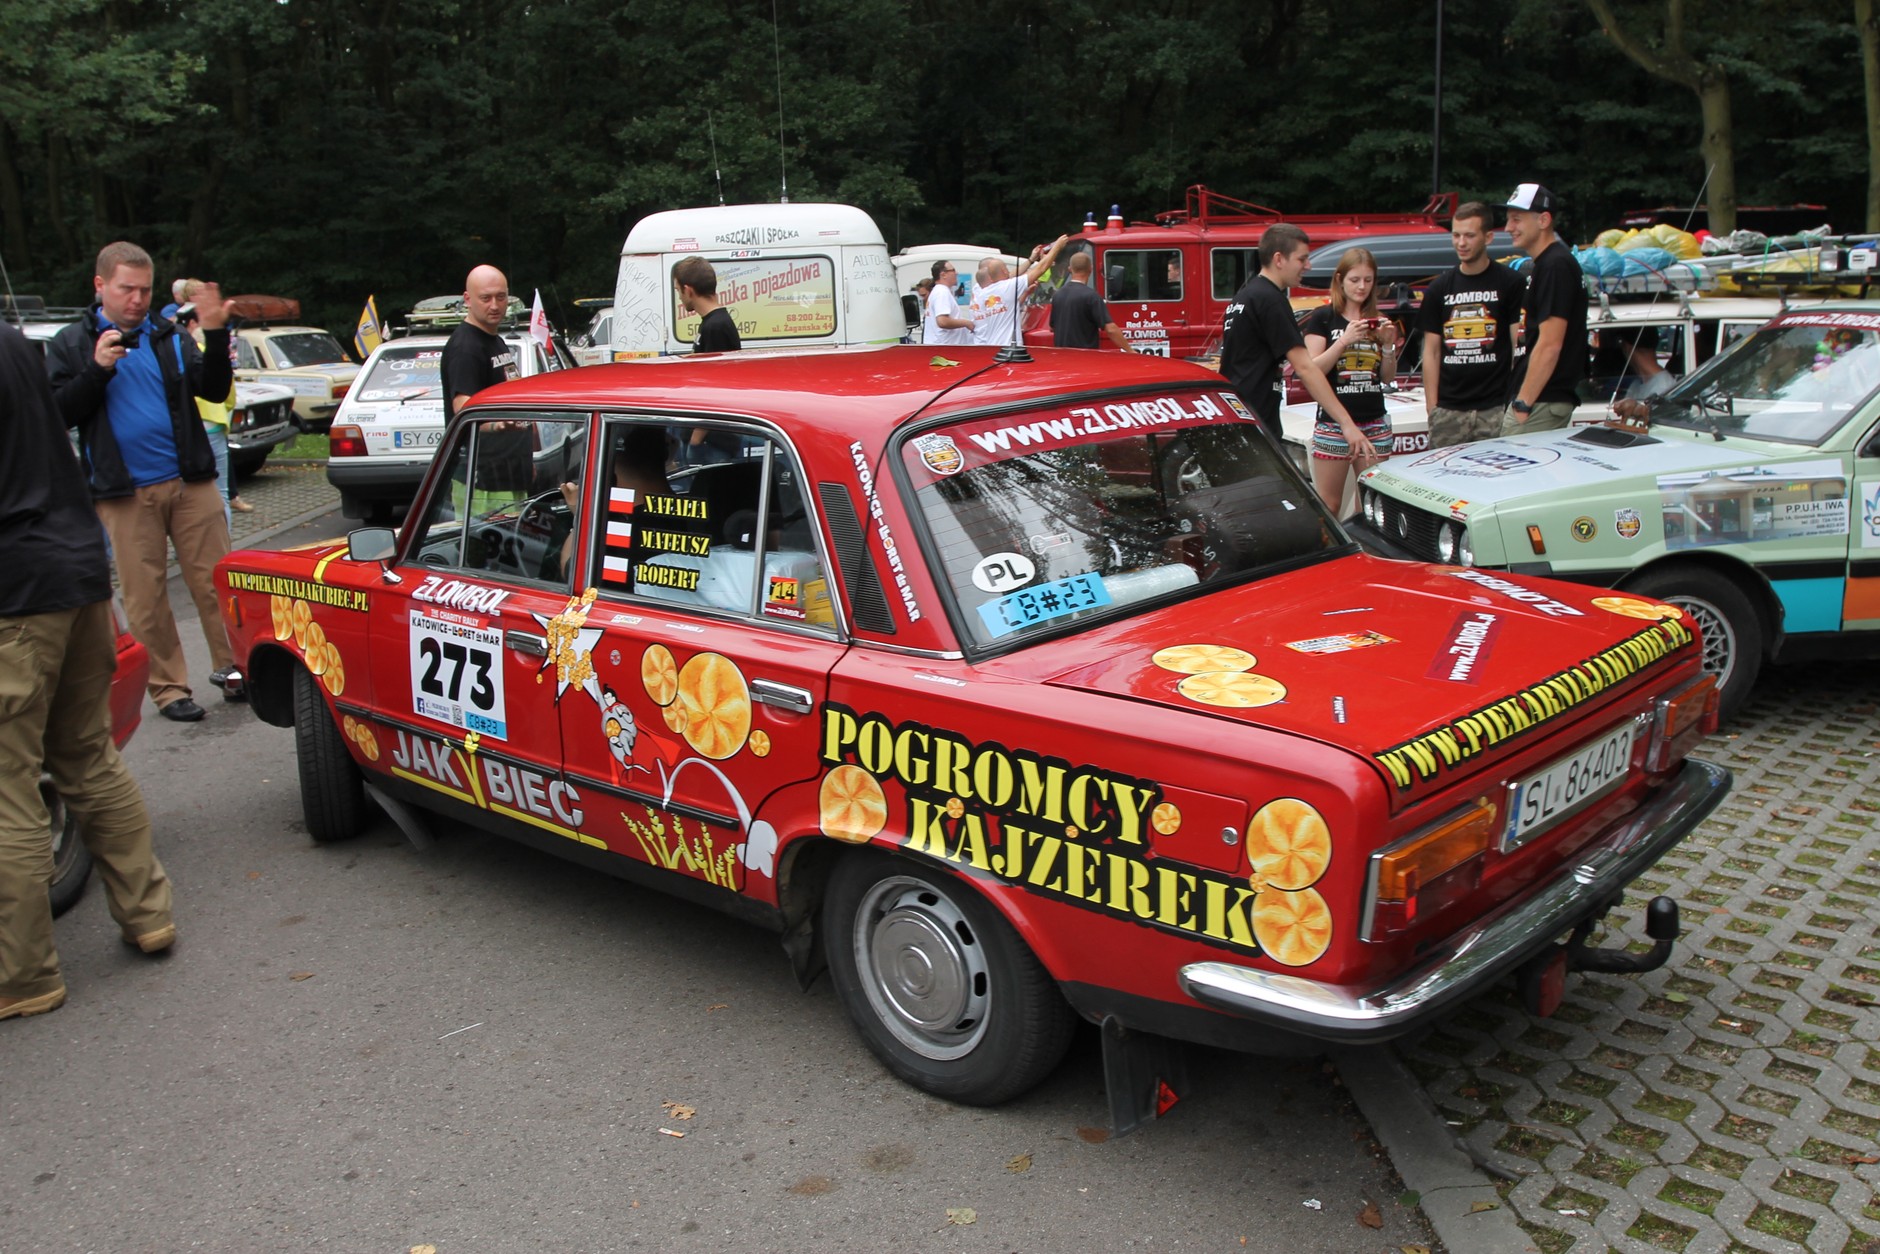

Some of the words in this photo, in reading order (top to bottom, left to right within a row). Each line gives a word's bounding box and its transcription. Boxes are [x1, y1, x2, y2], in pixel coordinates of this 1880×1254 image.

[715, 227, 759, 245] PASZCZAKI
[767, 227, 799, 243] SPÓŁKA
[753, 262, 821, 302] pojazdowa
[1475, 353, 1496, 363] MAR
[968, 394, 1222, 453] www.ZLOMBOL.pl
[403, 432, 421, 445] SY
[427, 432, 442, 445] 69
[1402, 484, 1428, 496] LLORET
[643, 495, 708, 519] NATALIA
[1786, 503, 1822, 513] P.P.U.H.
[1825, 501, 1844, 510] IWA
[639, 530, 710, 556] MATEUSZ
[1580, 525, 1589, 534] 7
[636, 563, 699, 590] ROBERT
[981, 562, 1027, 587] PL
[227, 571, 369, 612] WWW.PIEKARNIAJAKUBIEC.PL
[411, 575, 510, 616] ZLOMBOL
[900, 585, 921, 623] MAR
[462, 616, 480, 627] RALLY
[483, 632, 500, 646] MAR
[1449, 613, 1496, 680] www.ZLOMBOL.pl
[419, 636, 495, 711] 273
[1376, 618, 1693, 788] WWW.PIEKARNIAJAKUBIEC.PL
[823, 708, 1156, 845] POGROMCY
[1523, 774, 1553, 827] SL
[1565, 731, 1629, 803] 86403
[903, 798, 1258, 948] KAJZEREK
